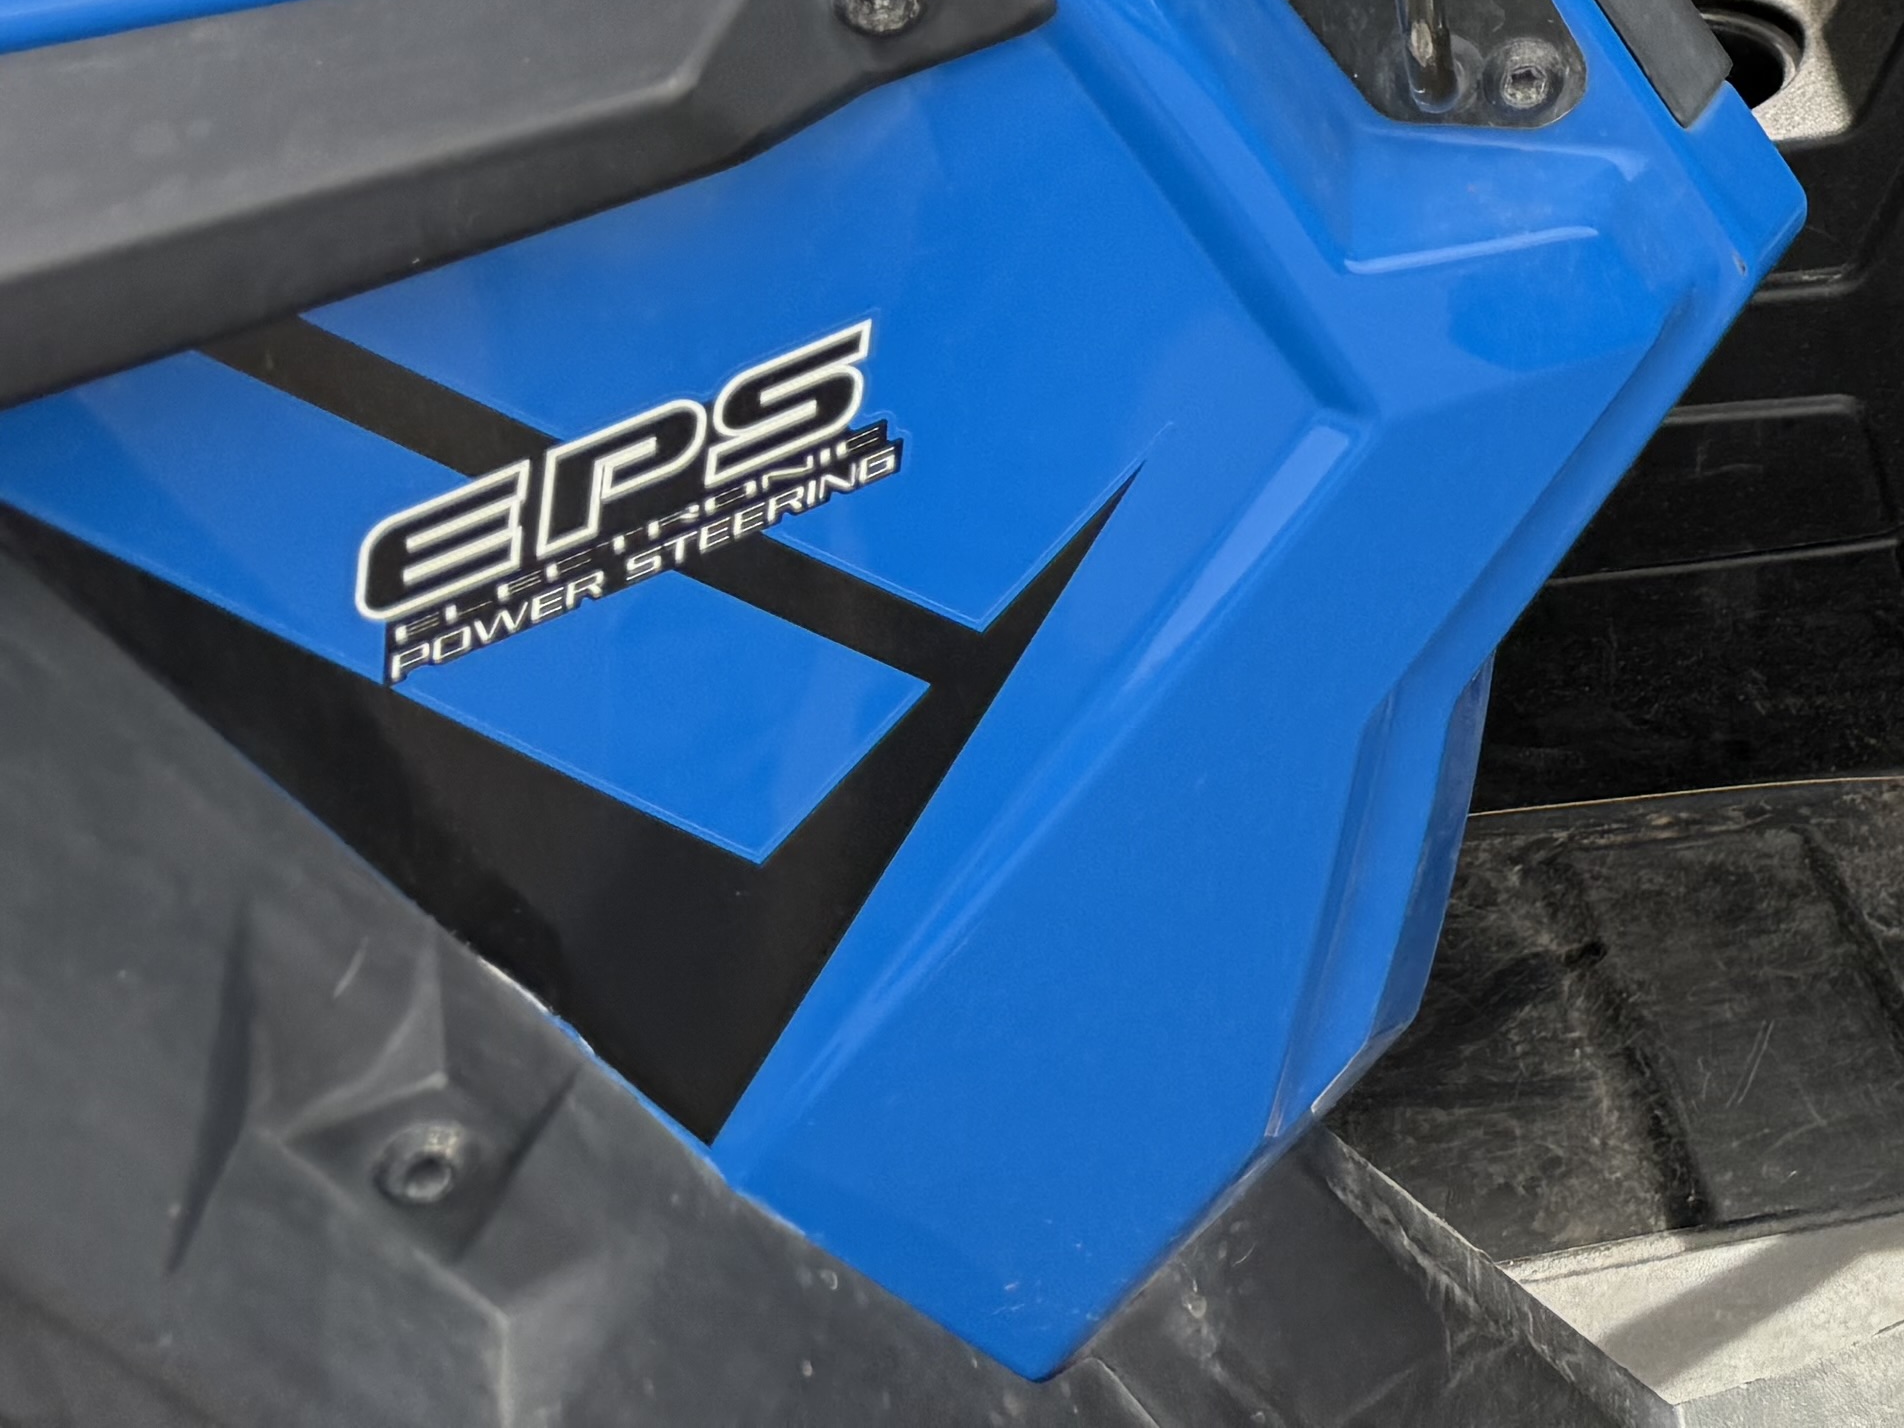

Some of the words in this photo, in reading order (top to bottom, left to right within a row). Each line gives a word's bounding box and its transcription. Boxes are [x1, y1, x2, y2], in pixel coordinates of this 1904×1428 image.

[355, 318, 872, 622] EPS
[389, 571, 604, 684] POWER
[625, 445, 897, 582] STEERING
